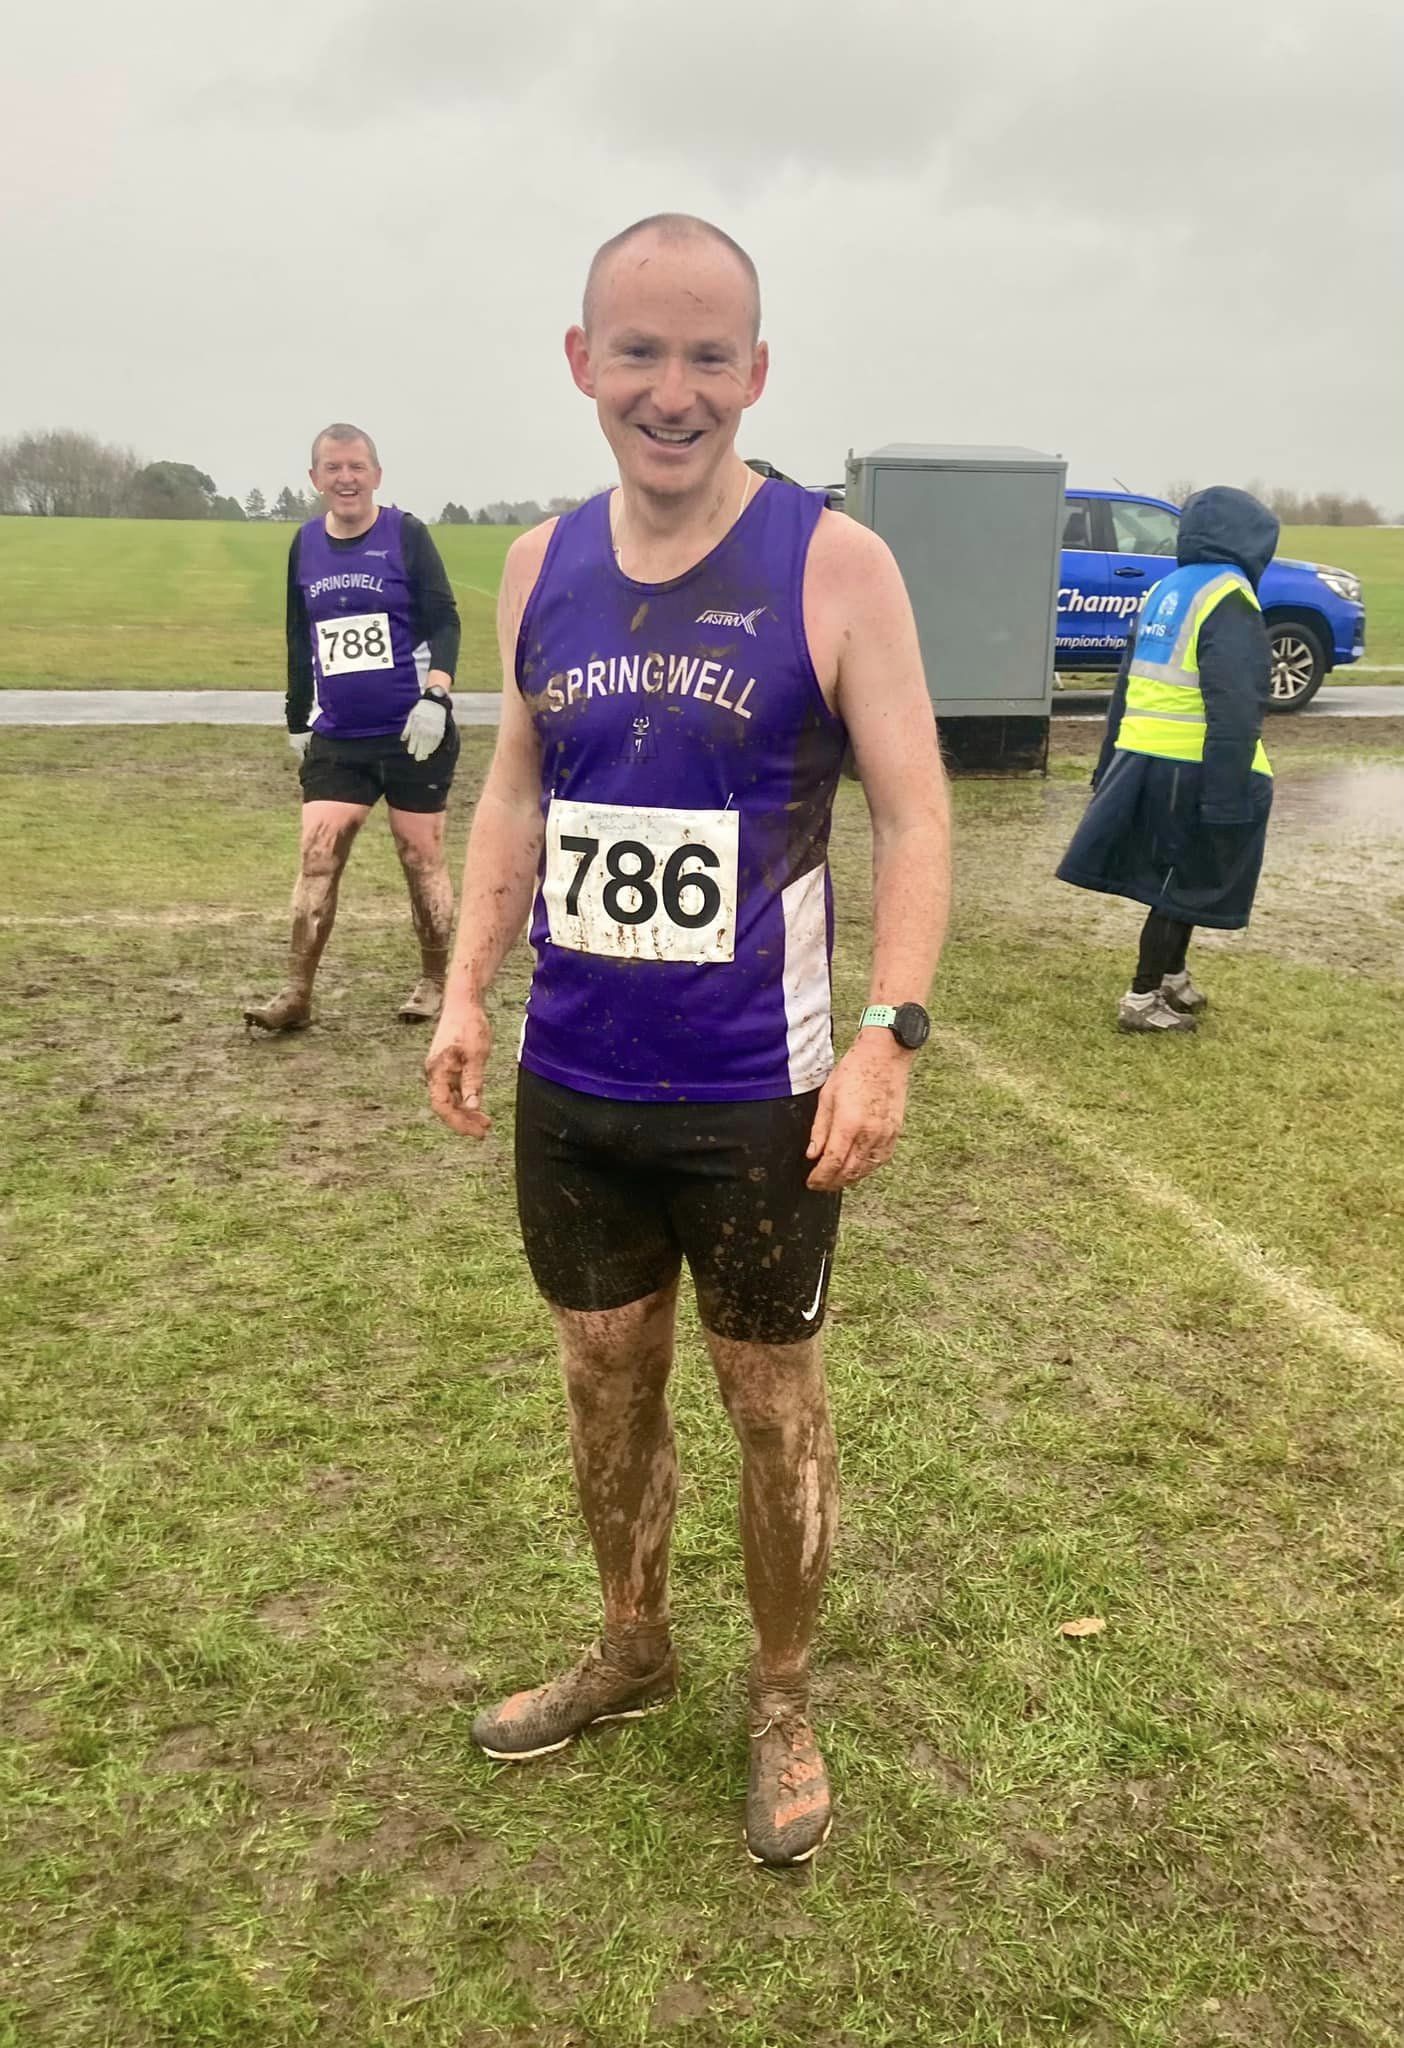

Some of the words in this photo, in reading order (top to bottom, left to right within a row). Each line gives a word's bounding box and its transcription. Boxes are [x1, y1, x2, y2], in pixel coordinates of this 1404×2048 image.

[310, 573, 384, 598] SPRINGWELL
[323, 627, 386, 662] 788
[547, 653, 756, 719] SPRINGWELL
[560, 835, 721, 929] 786
